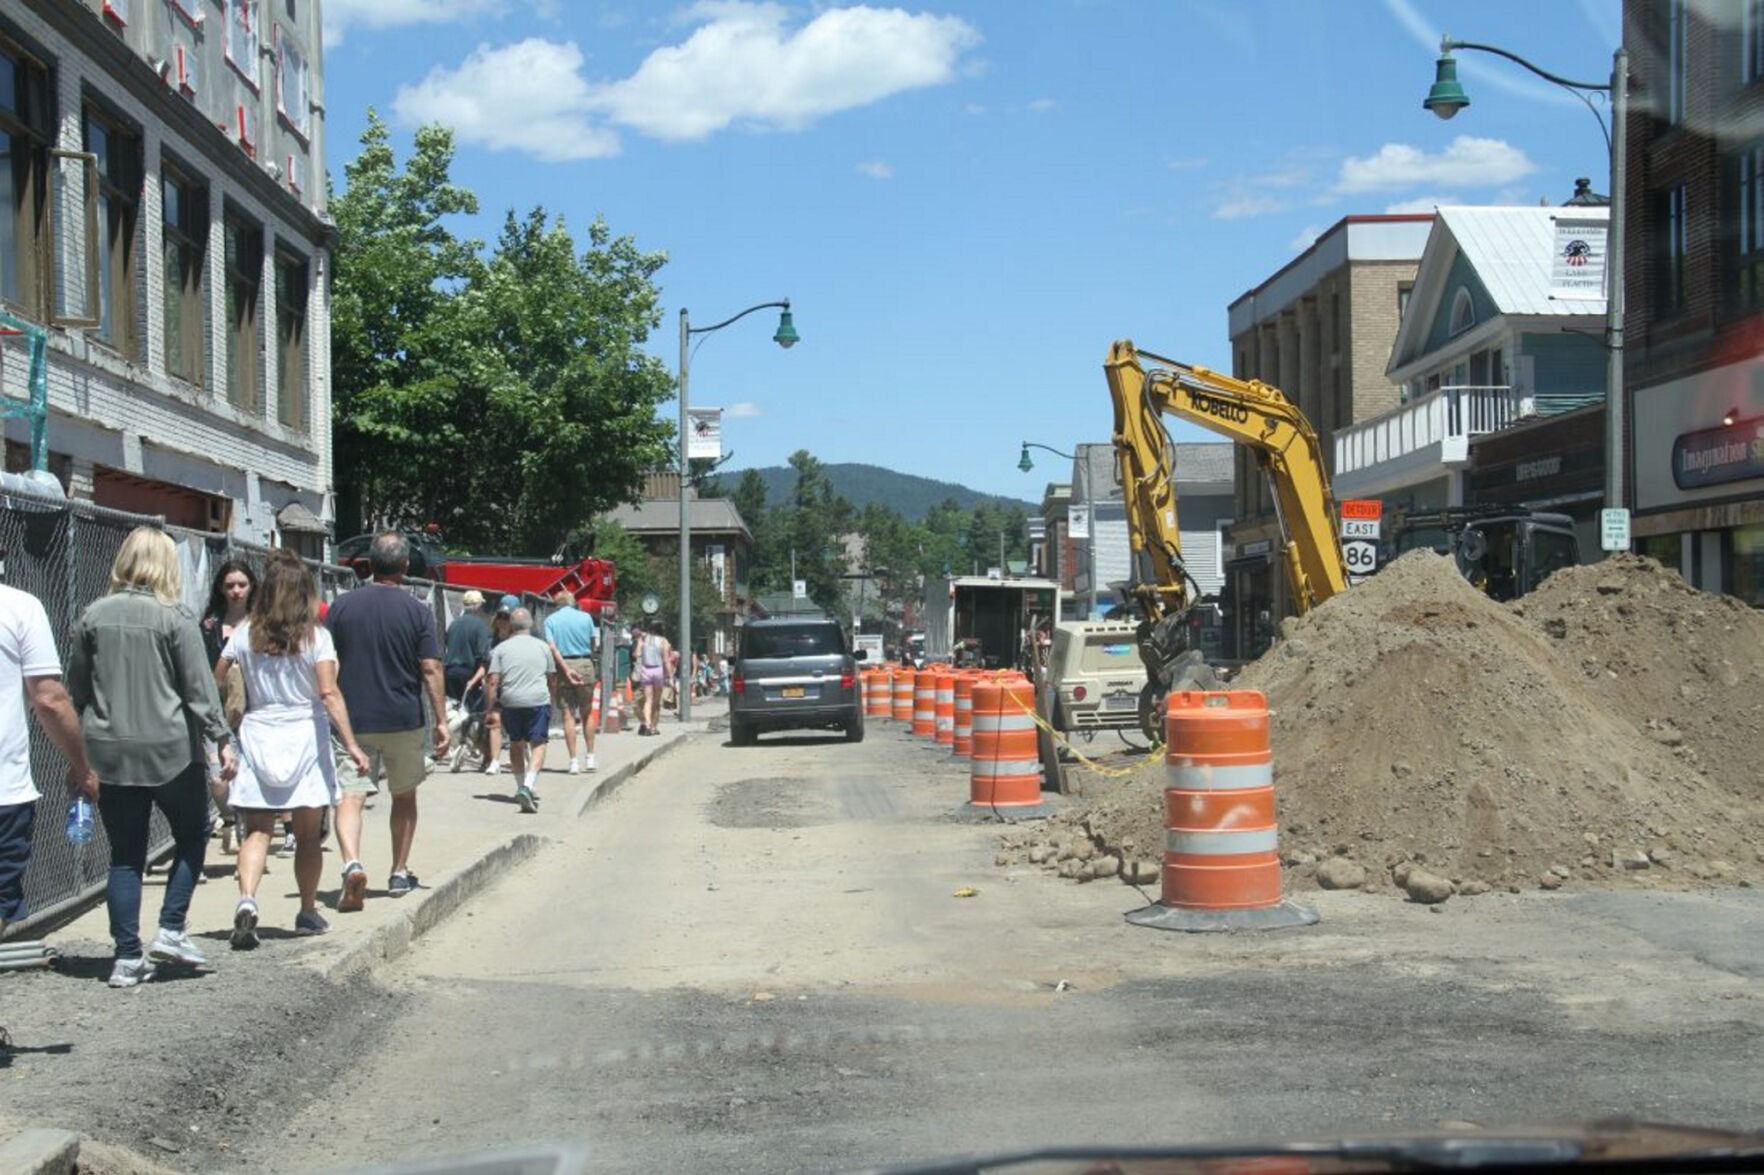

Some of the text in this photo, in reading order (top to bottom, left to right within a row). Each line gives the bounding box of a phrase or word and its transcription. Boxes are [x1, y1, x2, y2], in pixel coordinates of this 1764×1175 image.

[1682, 440, 1747, 474] Imagination
[1345, 502, 1378, 515] DETOUR
[1345, 522, 1374, 535] EAST
[1346, 546, 1373, 566] 86
